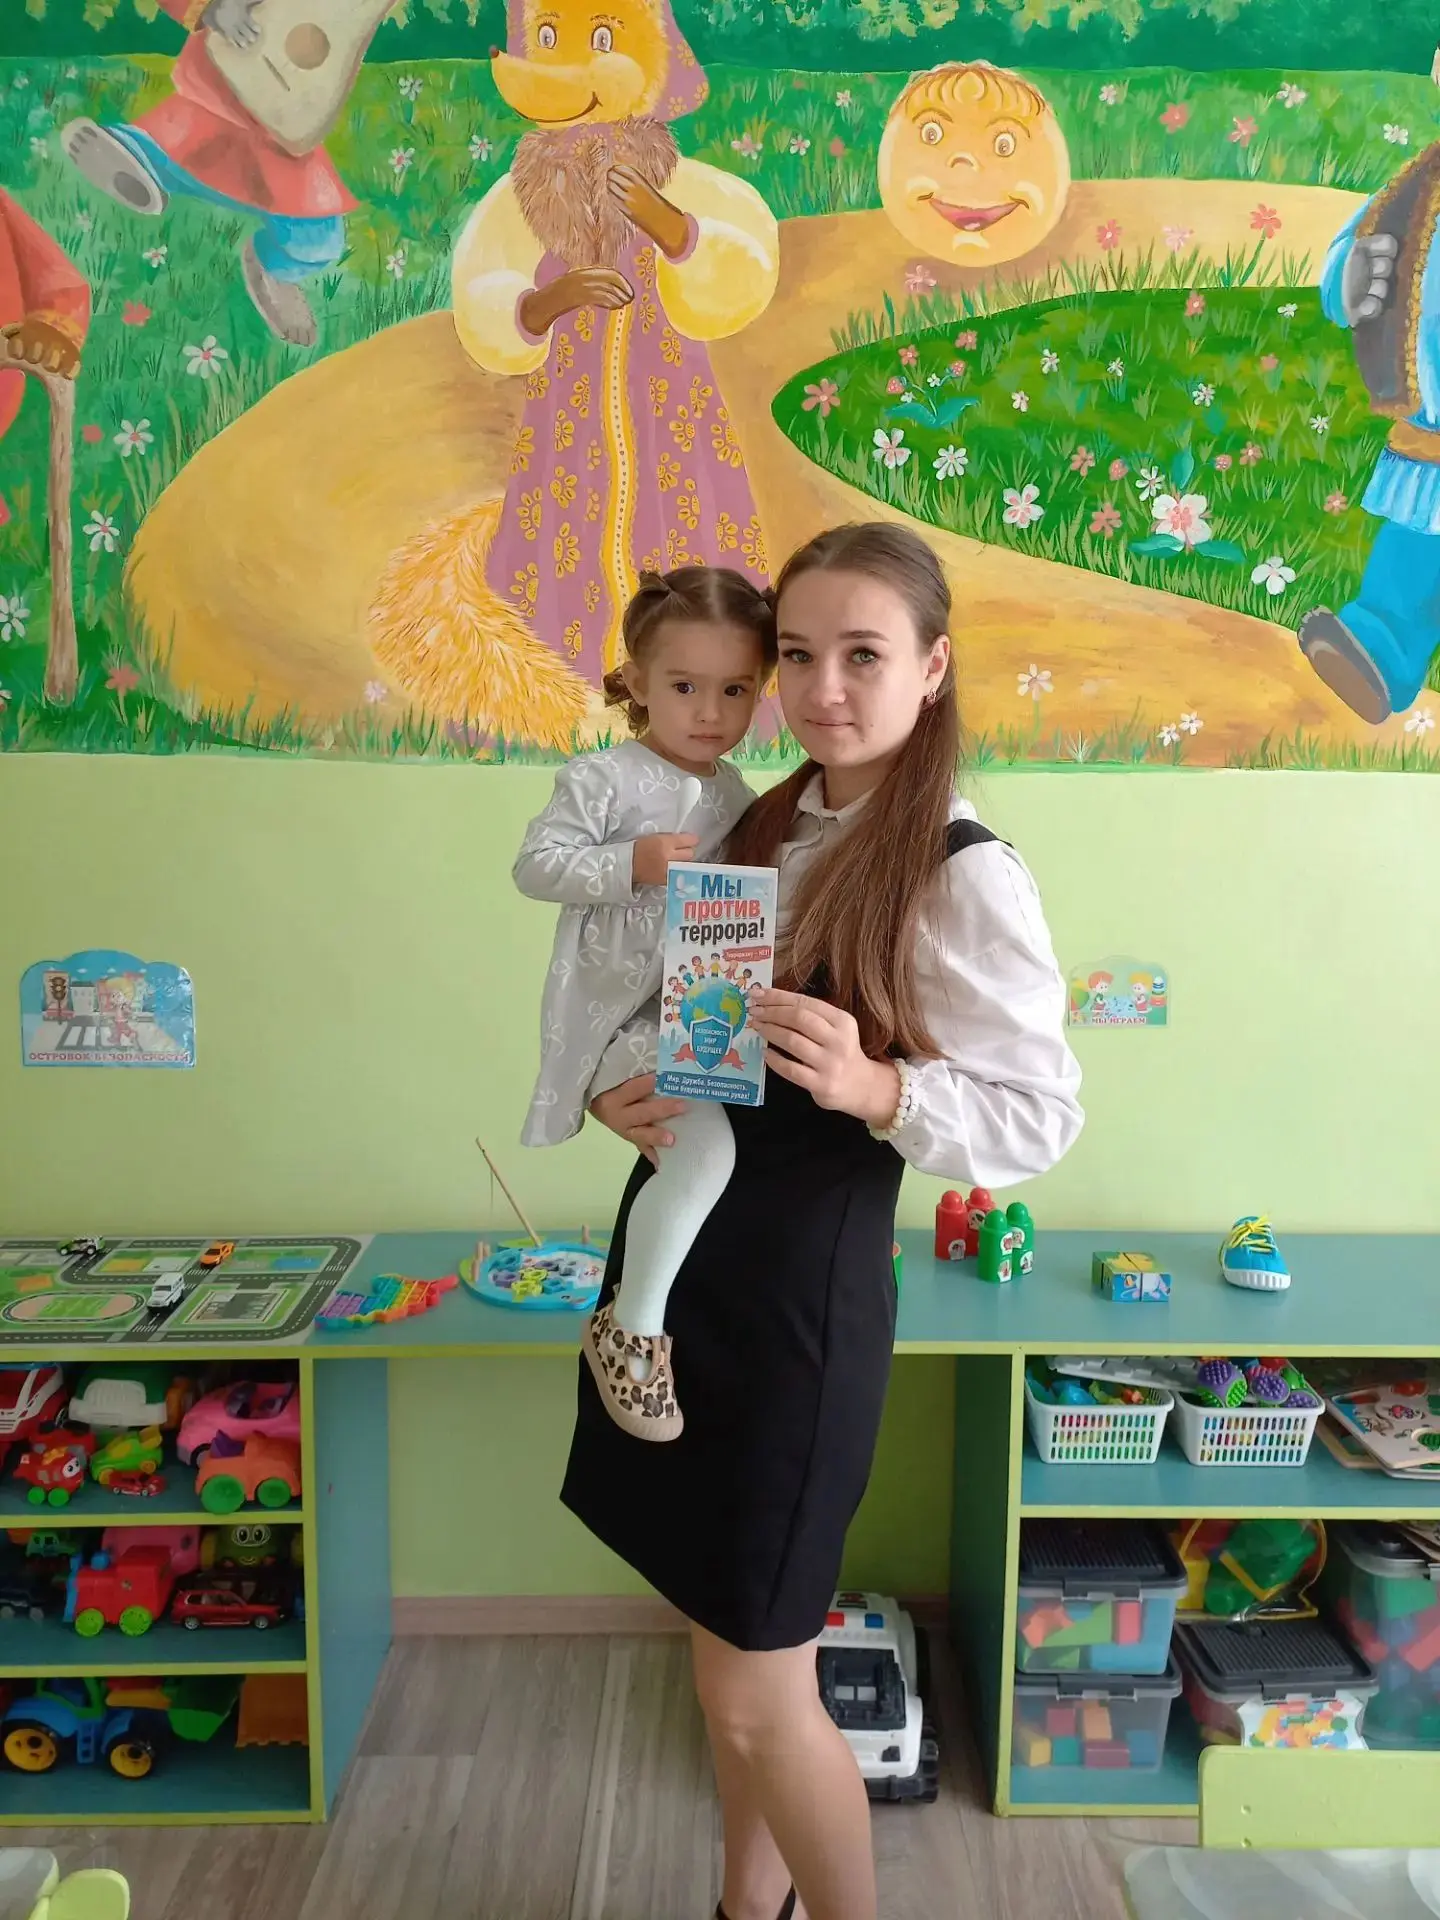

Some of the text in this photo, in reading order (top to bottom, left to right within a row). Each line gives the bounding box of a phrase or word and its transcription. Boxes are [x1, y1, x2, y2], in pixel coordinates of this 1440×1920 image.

[700, 874, 742, 898] Мы
[684, 899, 761, 924] против
[679, 917, 765, 946] террора!
[29, 1052, 91, 1061] ОСТРОВОК
